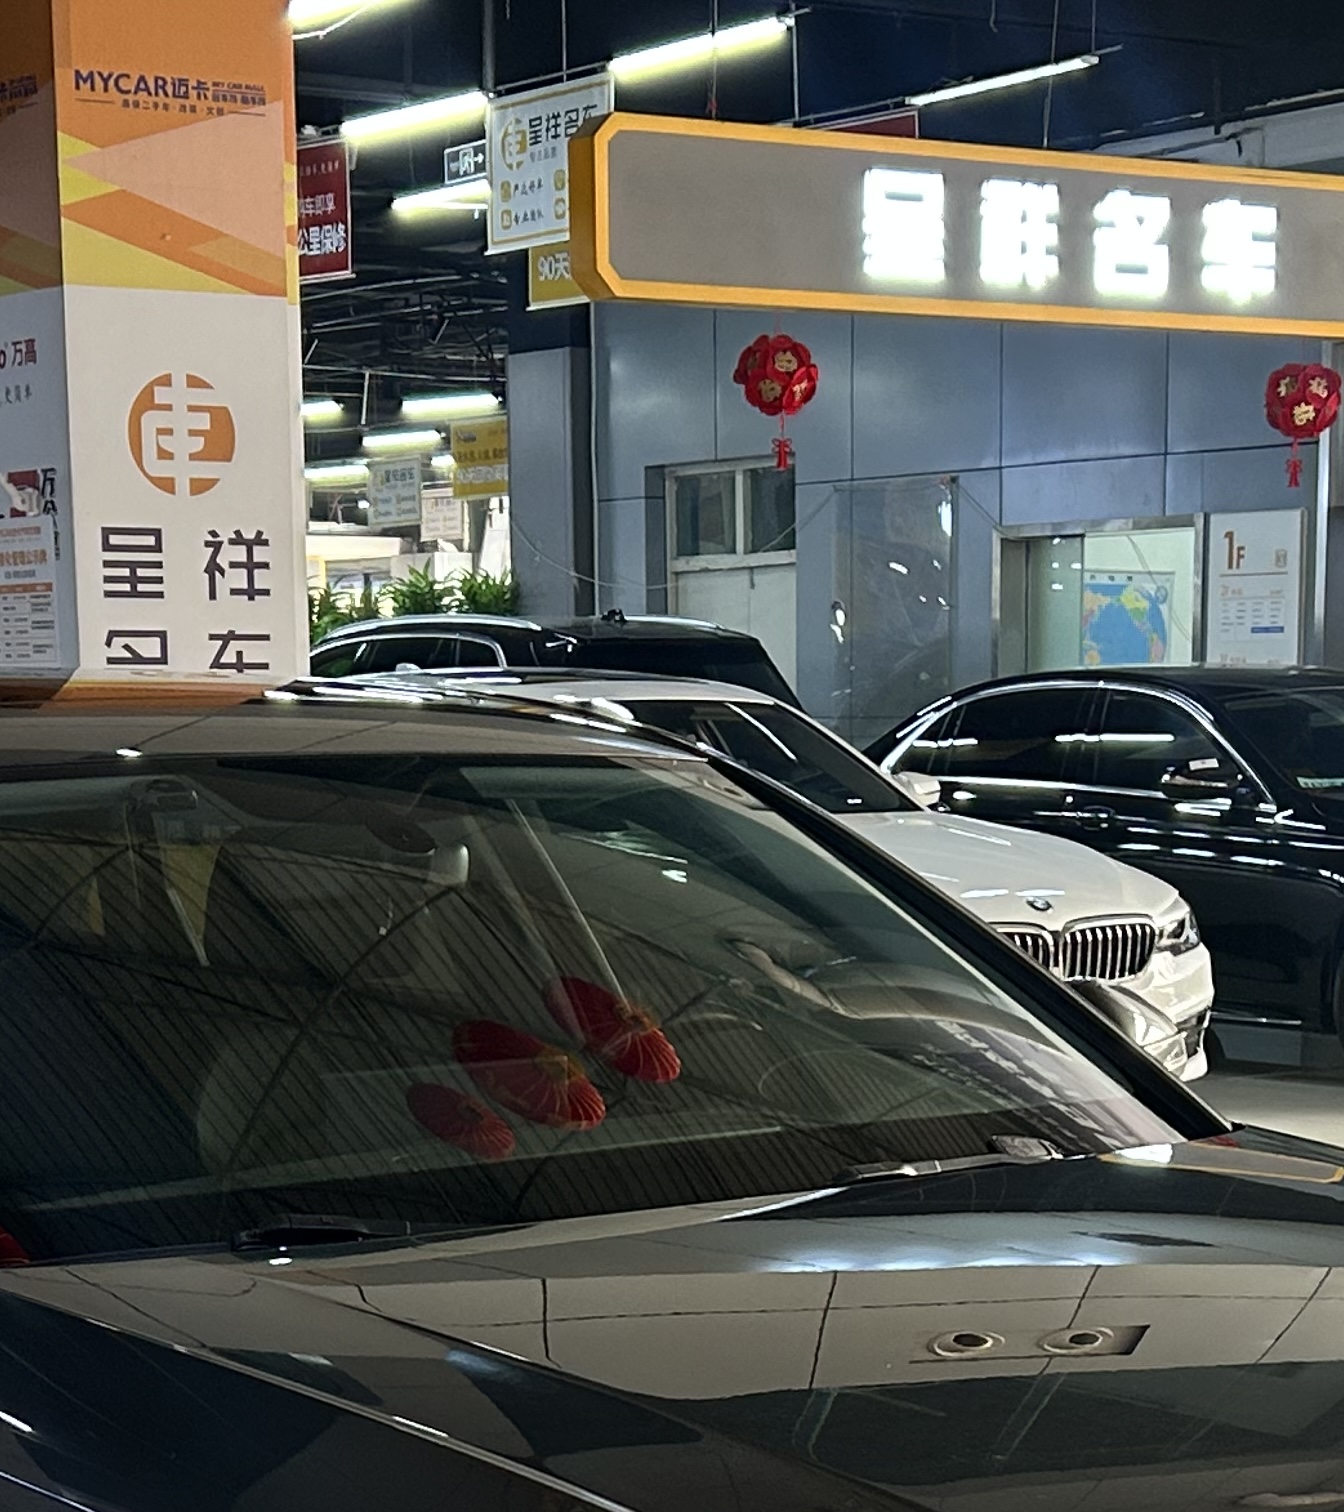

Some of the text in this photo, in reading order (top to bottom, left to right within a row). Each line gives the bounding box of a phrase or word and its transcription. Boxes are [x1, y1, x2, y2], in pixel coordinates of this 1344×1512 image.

[11, 339, 37, 367] 万高
[101, 527, 271, 600] 呈祥
[1224, 531, 1246, 570] 1F
